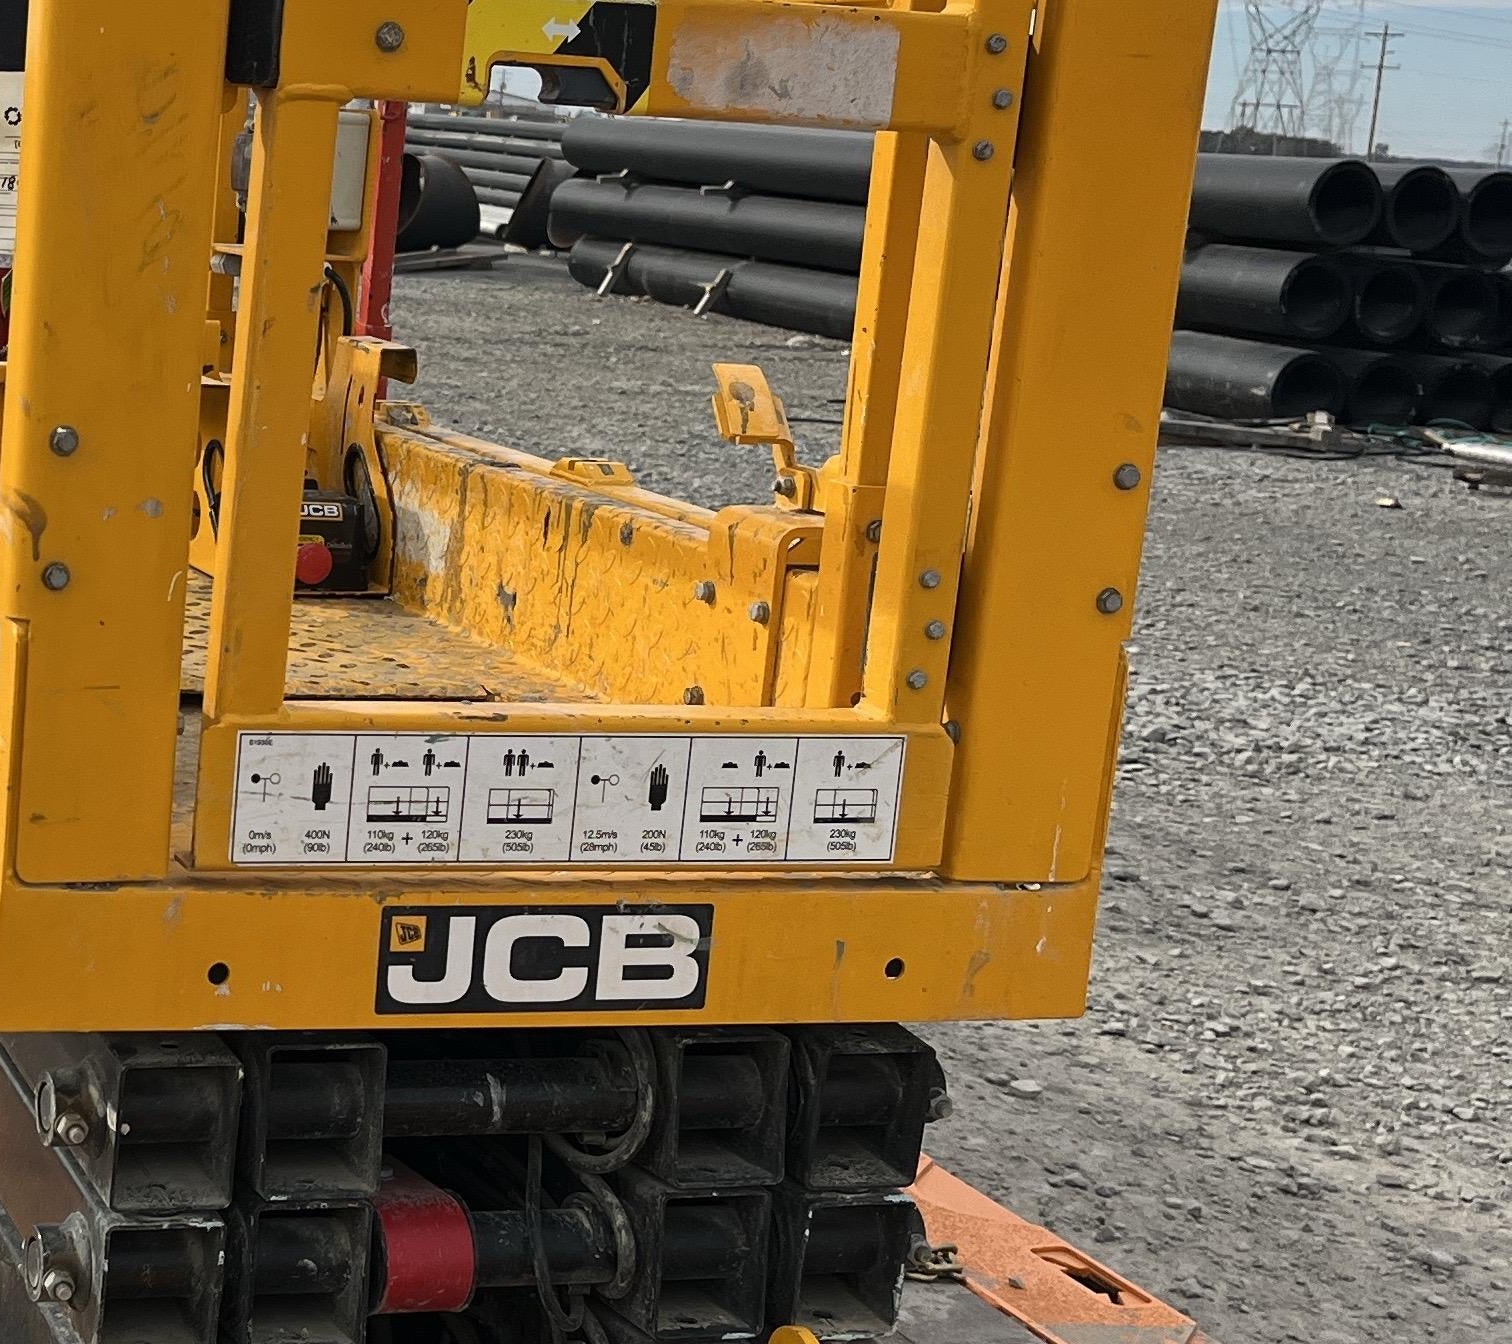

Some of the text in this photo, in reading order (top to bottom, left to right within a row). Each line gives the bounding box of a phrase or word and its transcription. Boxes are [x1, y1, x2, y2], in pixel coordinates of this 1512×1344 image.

[300, 504, 339, 517] JCB
[248, 829, 272, 840] 0m/s
[304, 829, 331, 840] 400N
[366, 829, 395, 842] 110kg
[421, 829, 449, 842] 120kg
[504, 829, 534, 842] 230kg
[583, 829, 618, 840] 12.5m/s
[641, 829, 667, 840] 200N
[698, 829, 725, 841] 110kg
[750, 829, 777, 841] 120kg
[829, 828, 857, 841] 230kg
[242, 841, 277, 855] (0mph)
[303, 841, 331, 854] (90lb)
[362, 841, 450, 855] (240lb) (265lb)
[501, 841, 534, 854] (505lb)
[579, 841, 618, 855] (28mph)
[640, 841, 666, 854] (45lb)
[695, 840, 727, 854] (240lb)
[826, 840, 857, 853] (505lb)
[386, 913, 701, 1004] JCB
